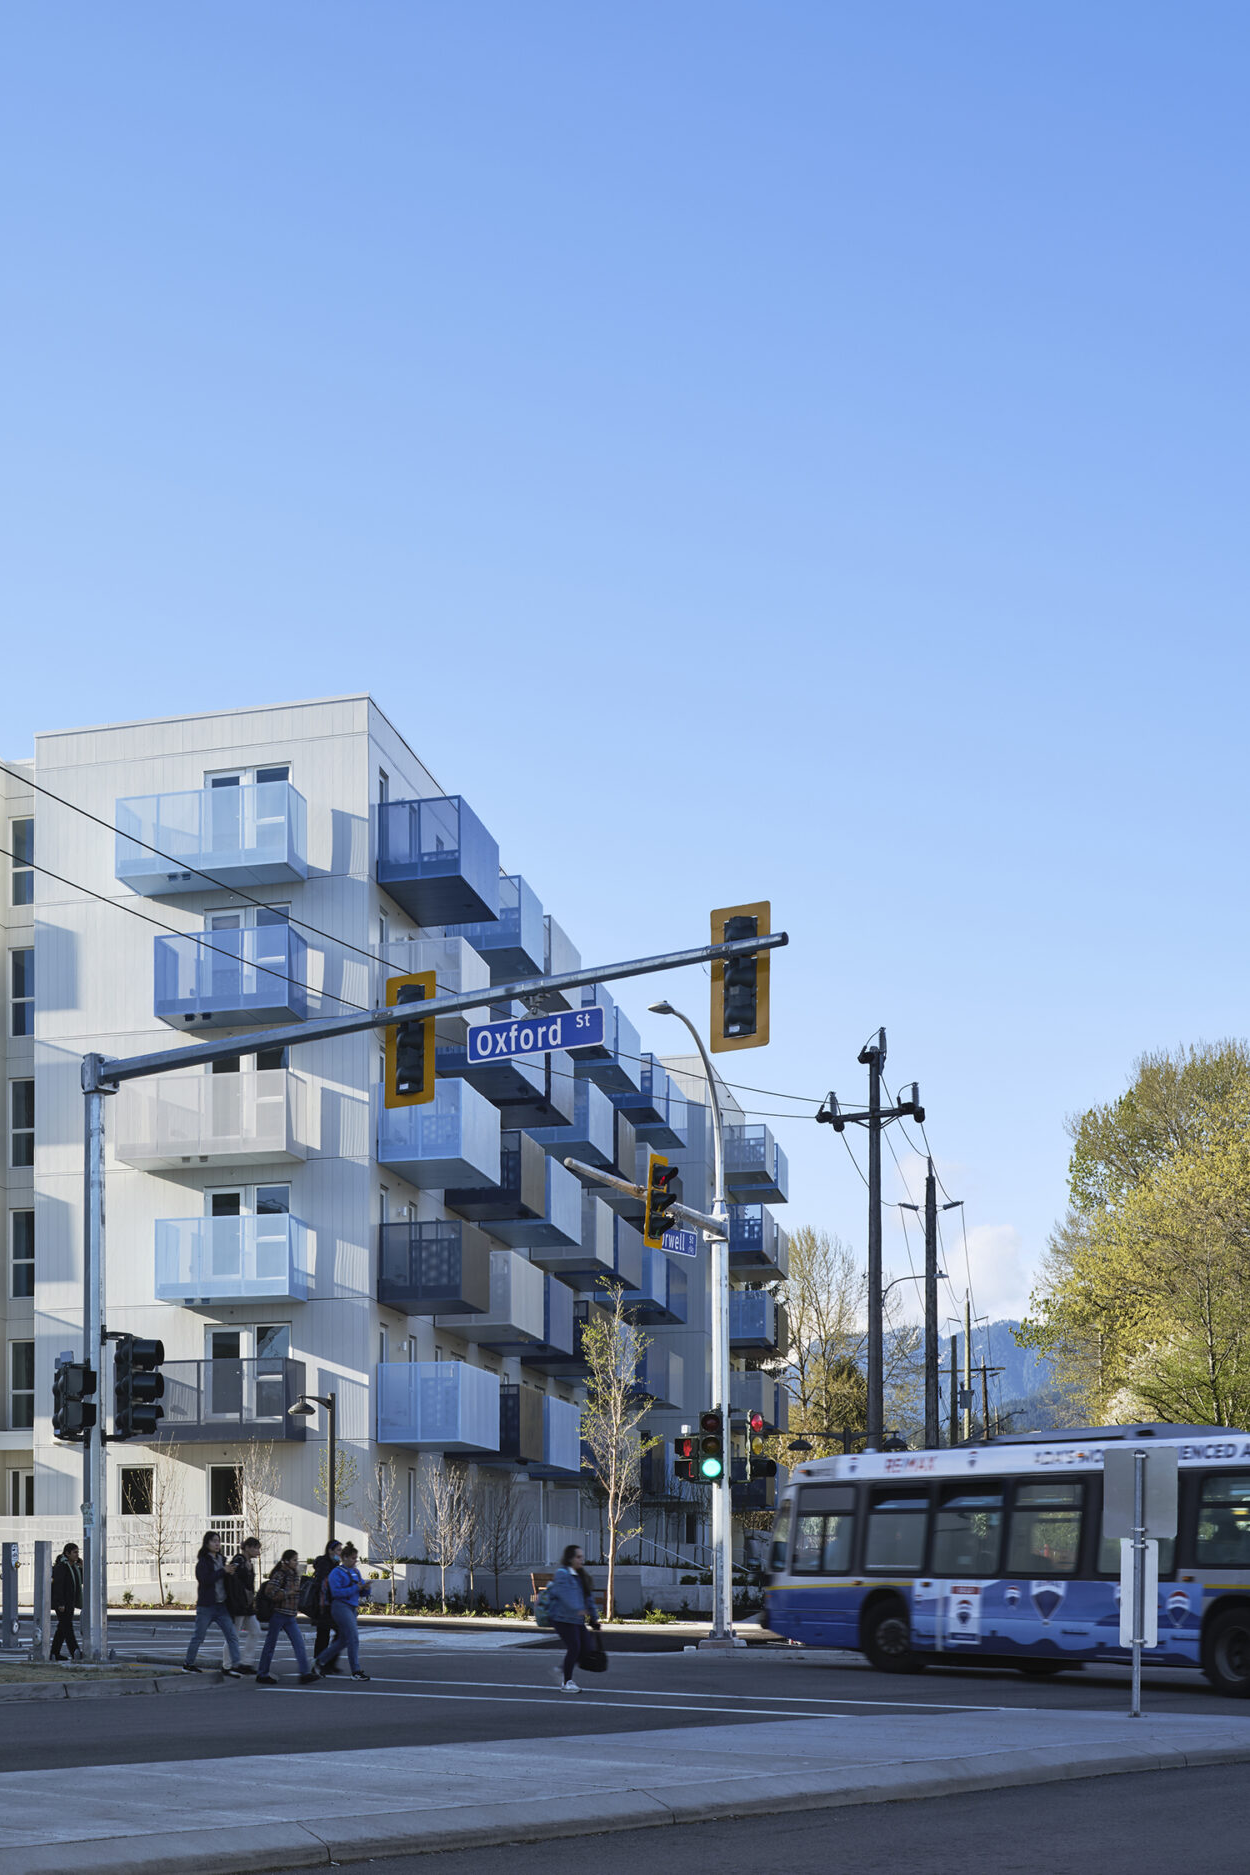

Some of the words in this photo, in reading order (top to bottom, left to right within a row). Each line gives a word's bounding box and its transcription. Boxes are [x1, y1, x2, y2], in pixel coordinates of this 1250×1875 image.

[476, 1017, 562, 1057] Oxford
[575, 1012, 591, 1028] St
[1178, 1443, 1237, 1460] IENCED
